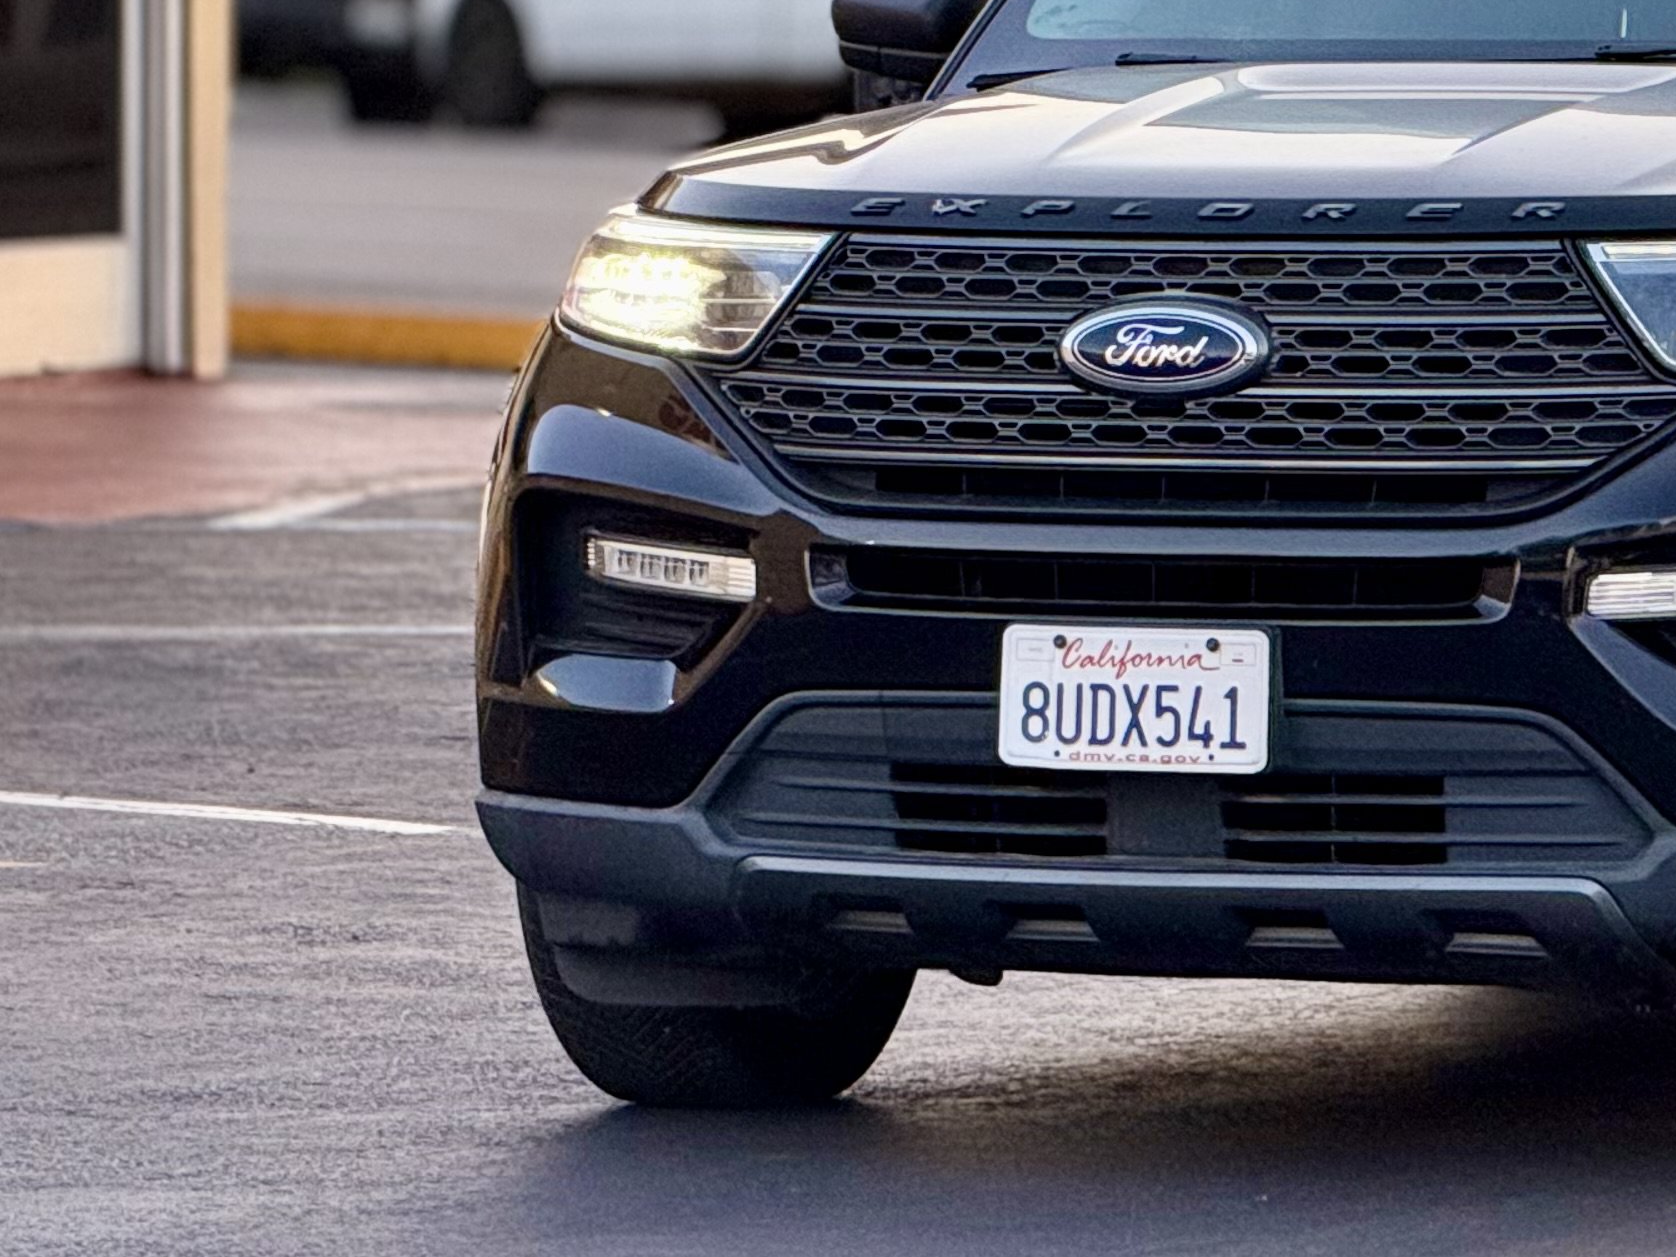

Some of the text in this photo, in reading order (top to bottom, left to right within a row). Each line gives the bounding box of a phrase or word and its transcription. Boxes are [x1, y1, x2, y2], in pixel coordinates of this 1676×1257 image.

[850, 197, 1566, 221] EXPLORER
[1104, 323, 1209, 368] Ford
[1061, 637, 1220, 680] California
[1020, 680, 1248, 750] 8UDX541
[1068, 750, 1201, 765] dmv.ca.gov
